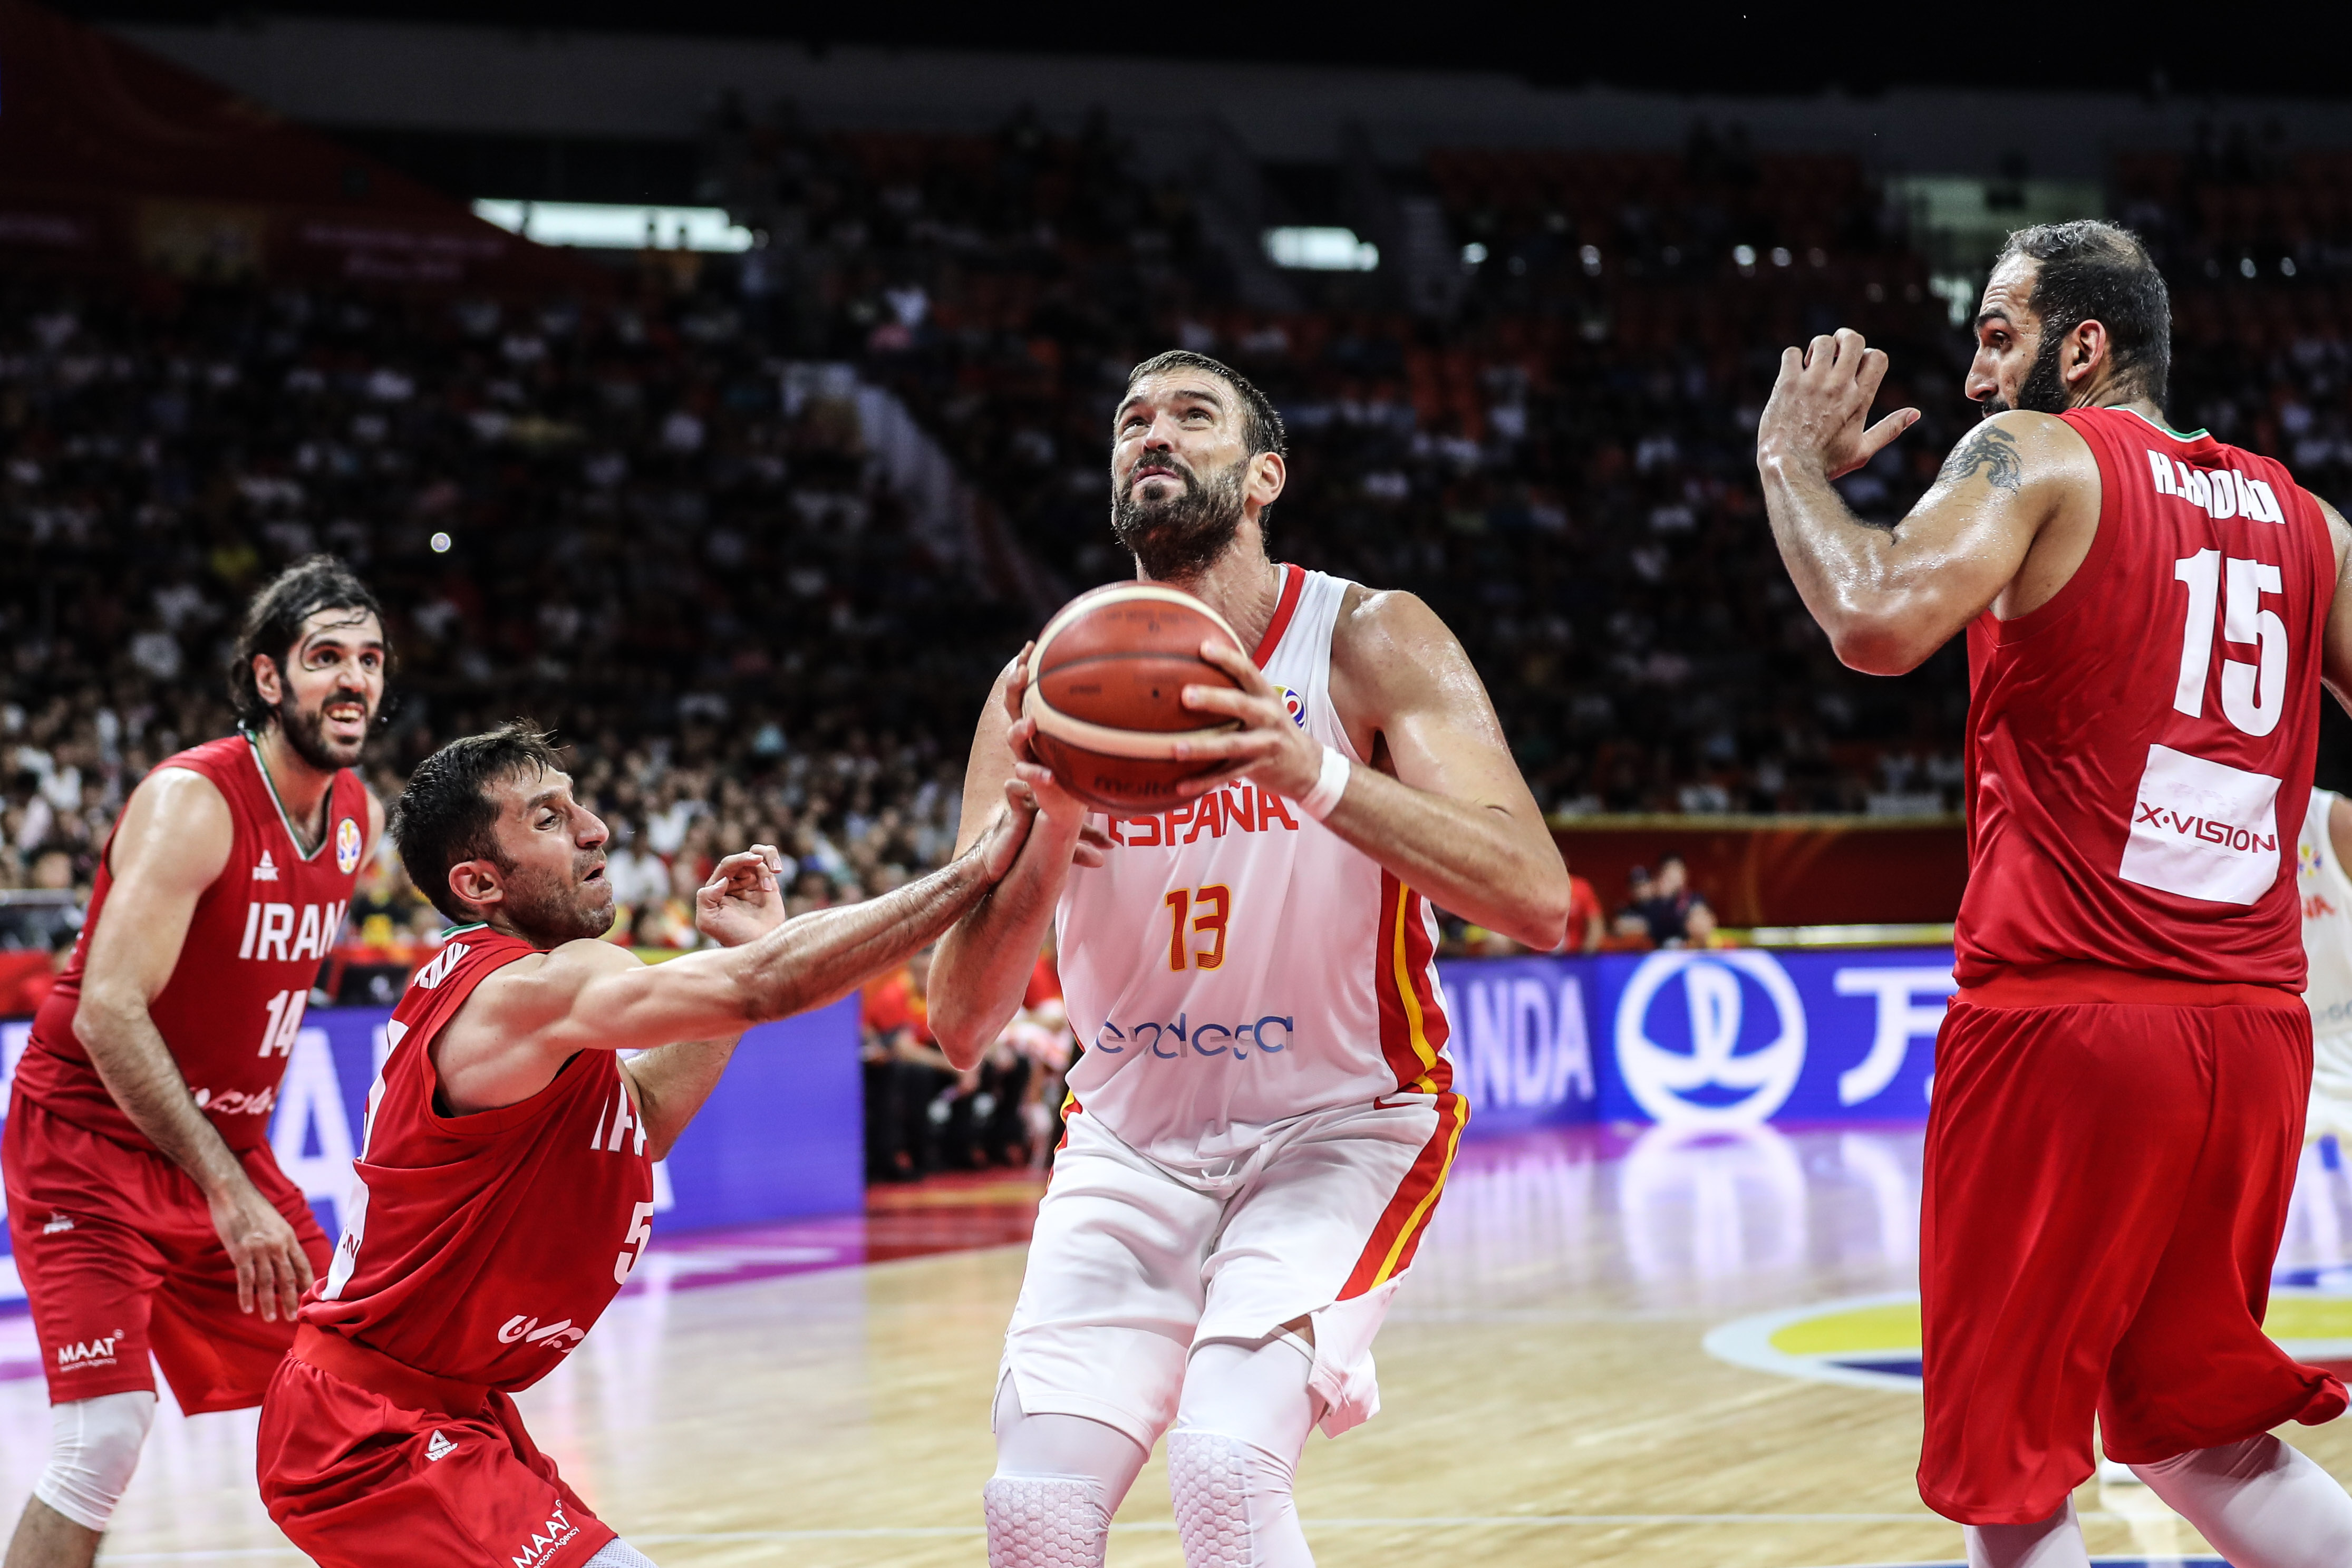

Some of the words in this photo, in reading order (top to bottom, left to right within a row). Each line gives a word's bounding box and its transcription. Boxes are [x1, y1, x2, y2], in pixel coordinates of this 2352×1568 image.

[2173, 547, 2288, 737] 15
[238, 899, 346, 961] IRAN
[1165, 884, 1231, 971] 13
[257, 989, 308, 1058] 14
[1096, 1012, 1293, 1060] endesa
[614, 1202, 653, 1285] 5
[58, 1337, 116, 1365] MAAT
[511, 1509, 570, 1568] MAAT
[554, 1526, 580, 1549] Agency
